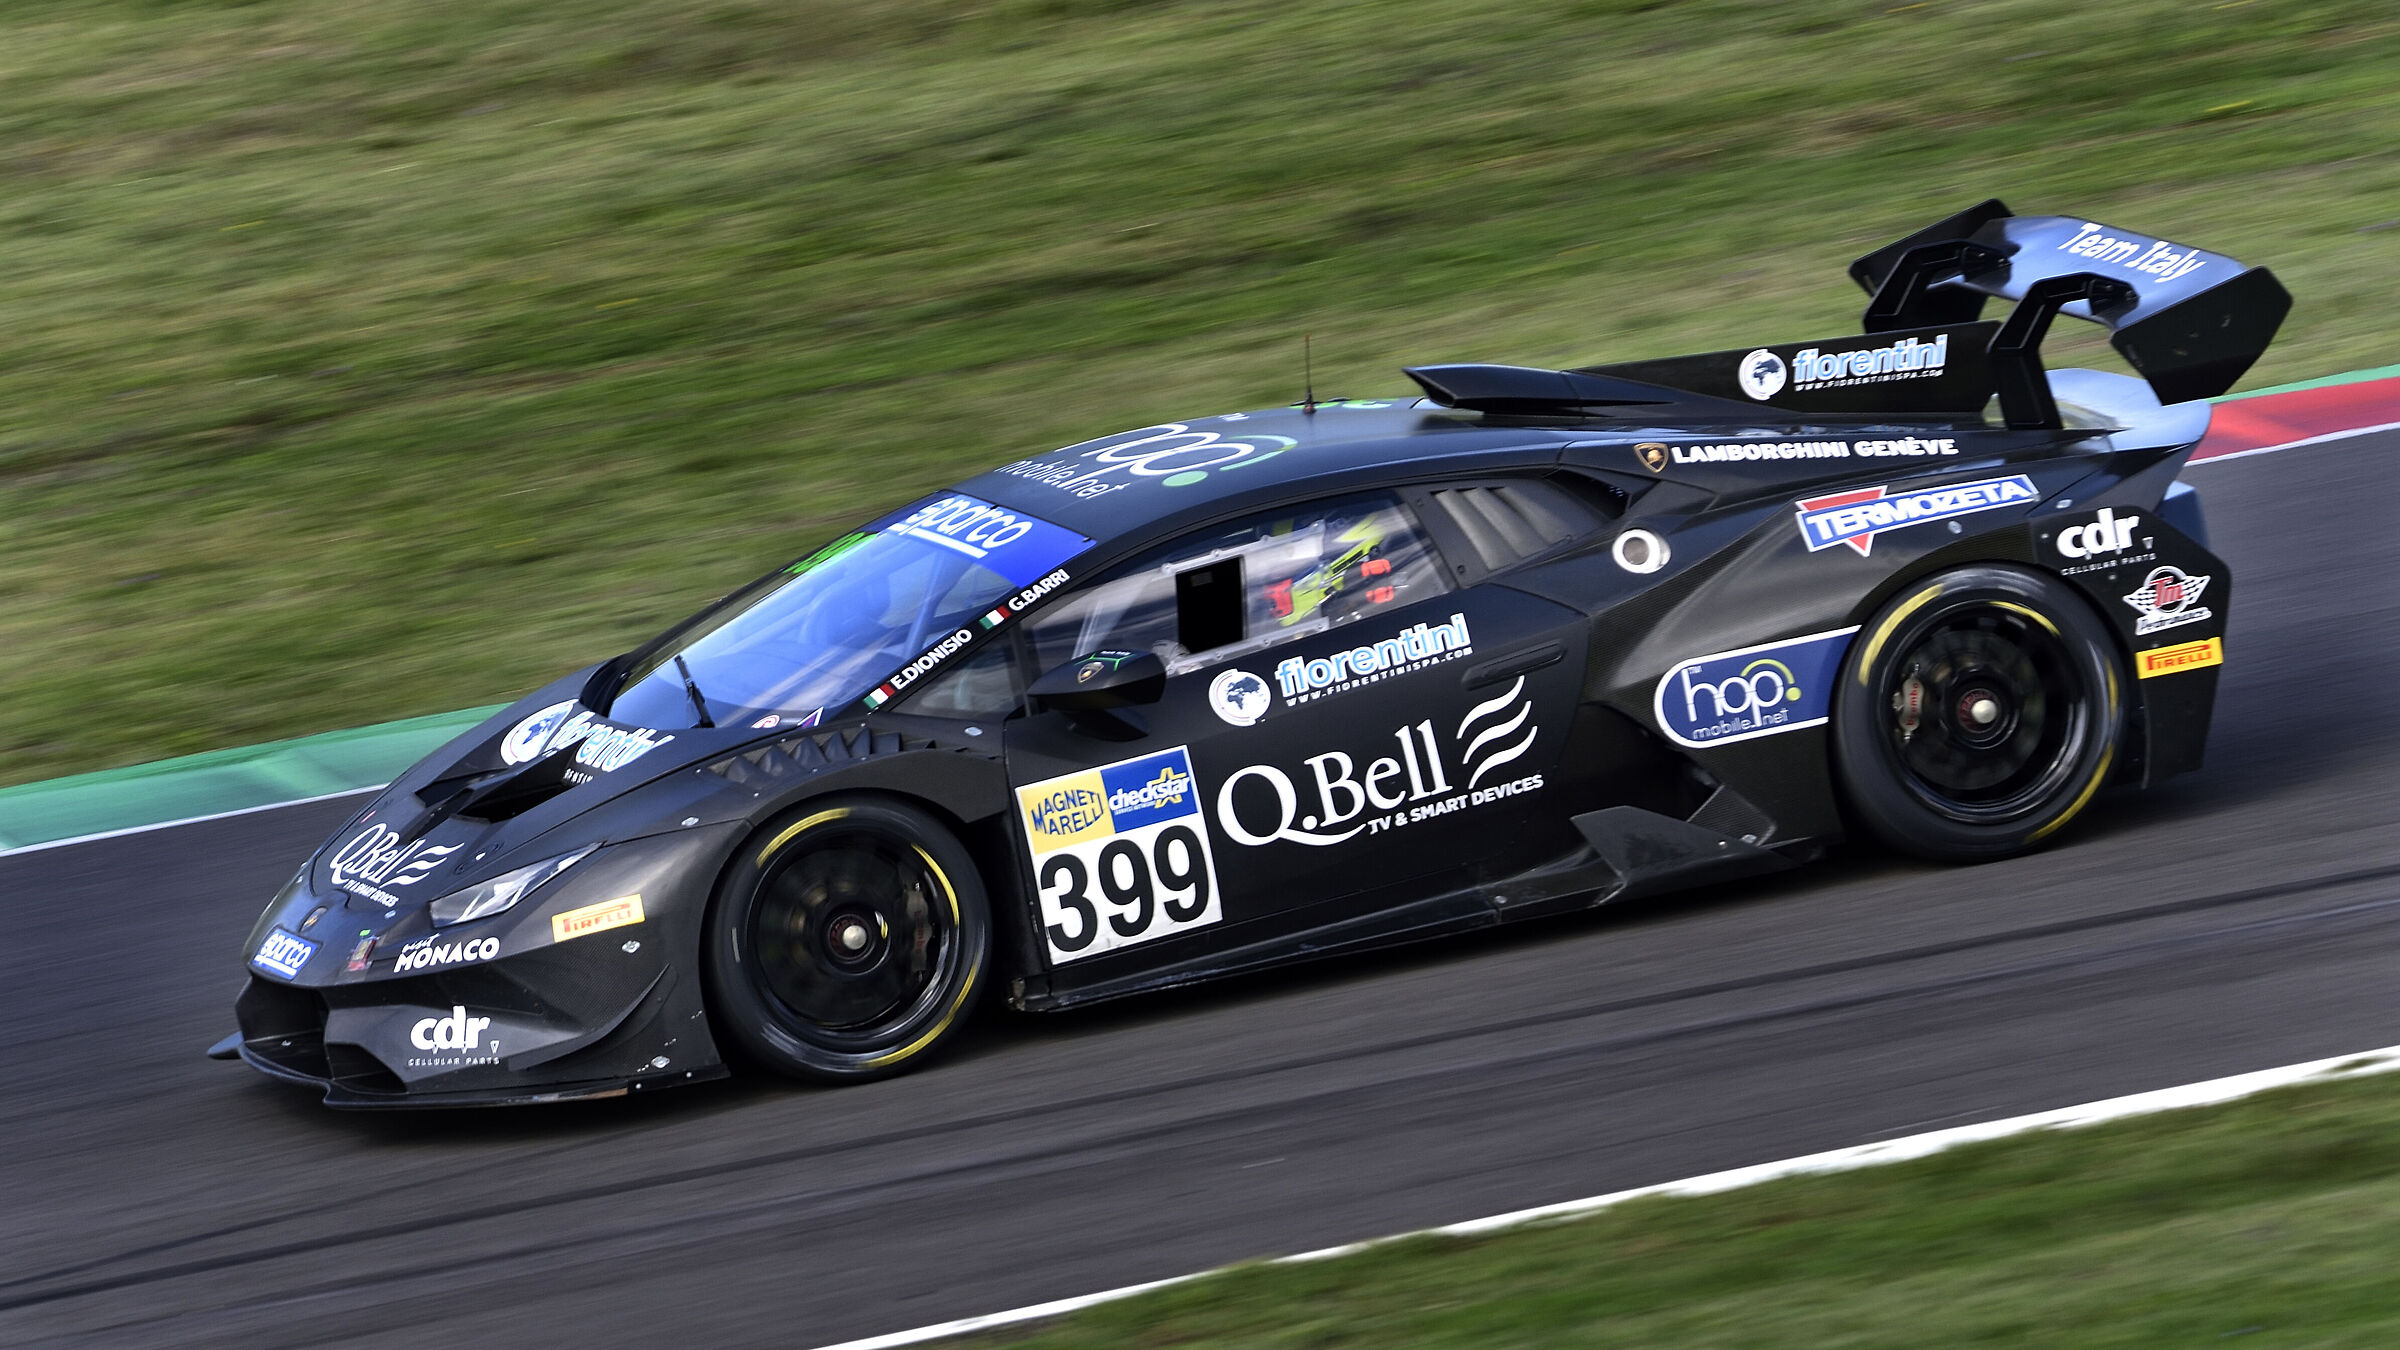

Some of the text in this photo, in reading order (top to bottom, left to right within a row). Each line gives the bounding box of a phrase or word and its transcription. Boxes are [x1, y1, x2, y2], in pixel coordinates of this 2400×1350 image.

[2057, 222, 2207, 284] Team Italy
[1792, 333, 1949, 384] fiorentini
[1671, 436, 1960, 464] LAMBORGHINI GENÈVE
[899, 497, 1033, 549] sparco
[1806, 480, 2034, 540] TERMOZETA
[2056, 507, 2140, 559] cdr
[1008, 568, 1071, 612] G.BARRI
[890, 628, 973, 691] E.DIONISIO
[1274, 612, 1472, 698] fiorentini
[1285, 646, 1474, 707] WWW.FIORENTINISPA.COM
[2147, 643, 2212, 671] PIRELLI
[1108, 776, 1191, 812] checkstar
[1216, 718, 1454, 847] Q.Bell
[1367, 774, 1545, 835] TV & SMART DEVICES
[1040, 824, 1210, 953] 399
[260, 932, 313, 970] sparco
[393, 936, 501, 974] MONACO
[410, 1005, 491, 1052] cdr
[407, 1055, 501, 1067] CELLULAR PARTS
